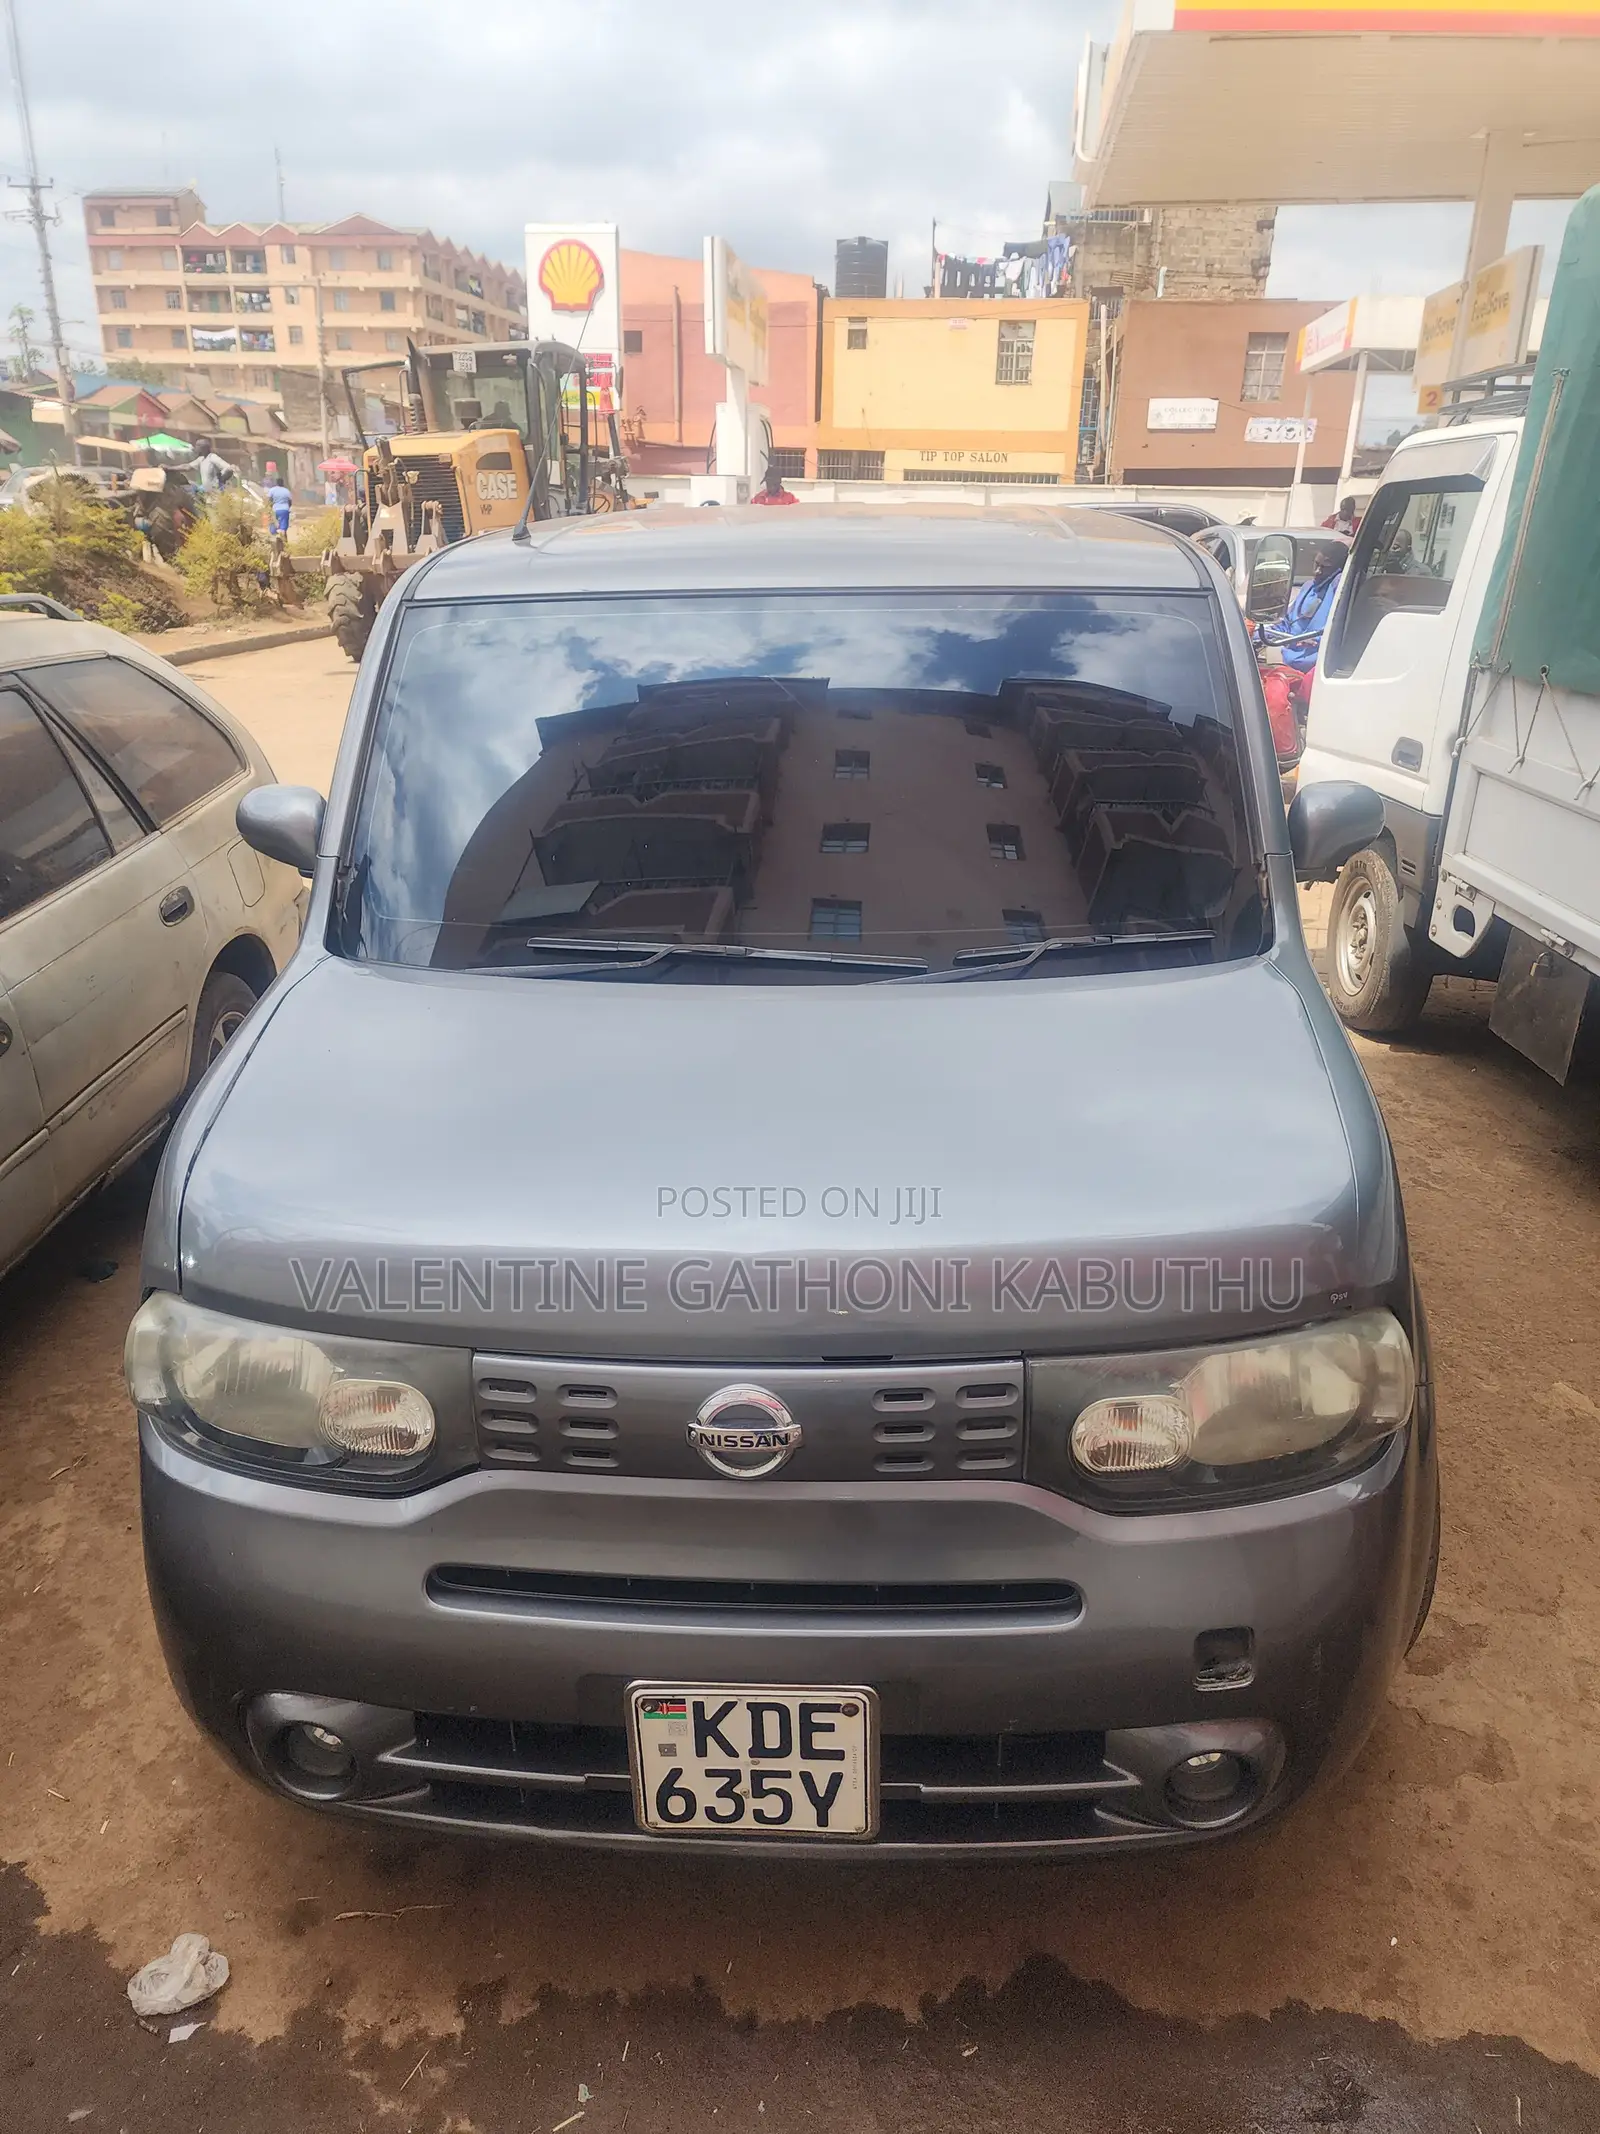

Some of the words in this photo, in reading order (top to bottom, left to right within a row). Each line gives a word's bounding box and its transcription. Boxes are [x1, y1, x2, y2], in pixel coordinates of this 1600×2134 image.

[1427, 391, 1438, 406] 2
[920, 451, 937, 462] TIP
[943, 451, 965, 462] TOP
[969, 452, 1008, 463] SALON
[476, 471, 518, 500] CASE
[699, 1433, 789, 1448] NISSAN
[692, 1700, 846, 1761] KDE
[656, 1767, 844, 1827] 635Y
